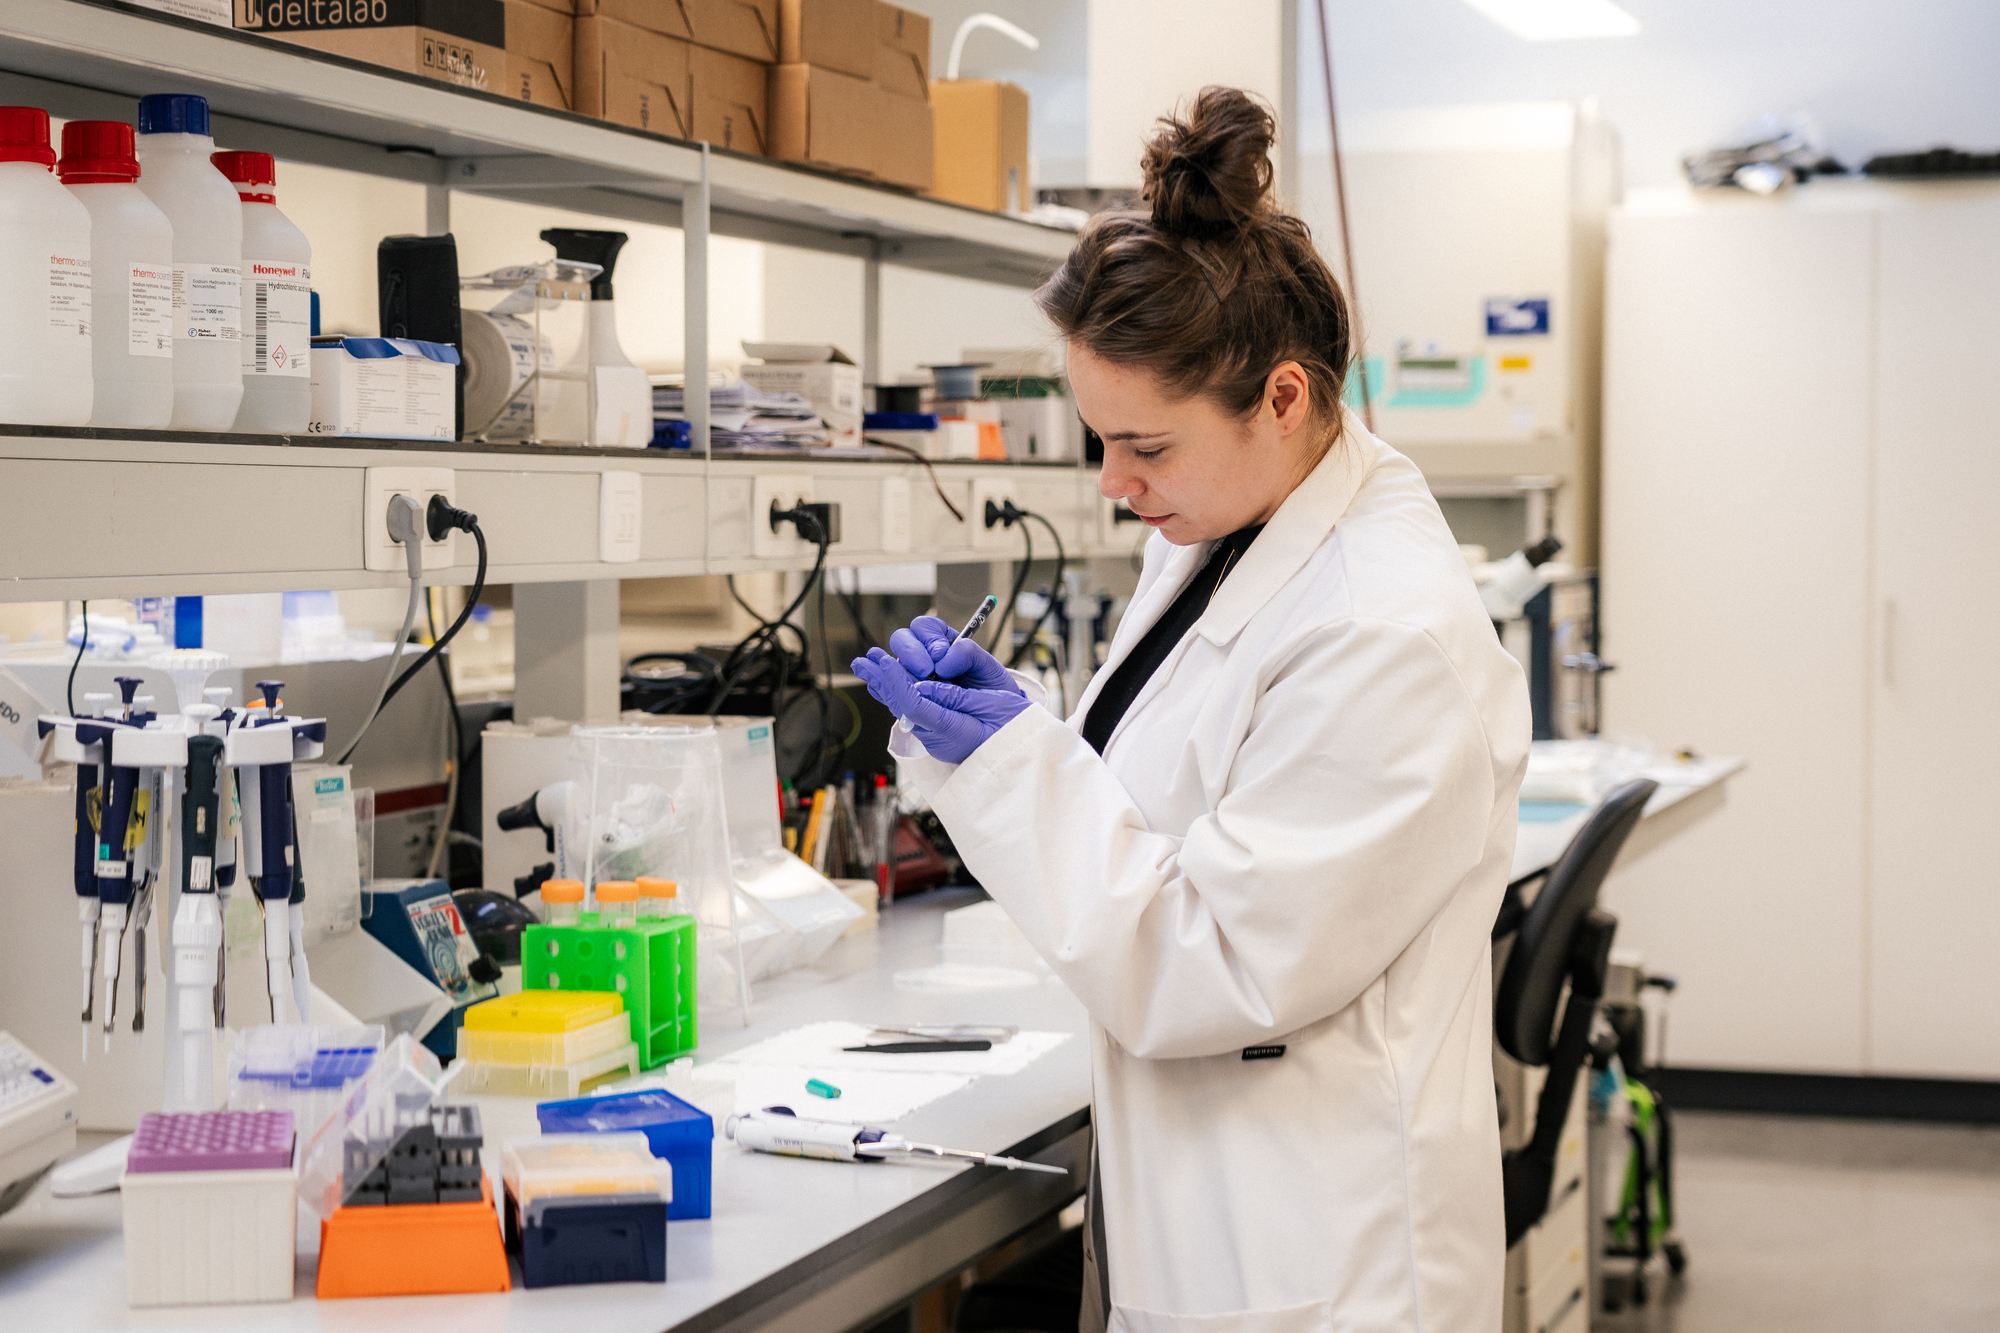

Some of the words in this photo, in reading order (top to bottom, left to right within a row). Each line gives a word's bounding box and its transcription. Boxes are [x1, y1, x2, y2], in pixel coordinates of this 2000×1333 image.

[268, 0, 387, 27] deltalab
[50, 254, 76, 266] thermo
[133, 268, 157, 279] thermo
[210, 267, 236, 275] VOLUMETRIC
[253, 264, 296, 278] Honeywell
[268, 281, 298, 291] Hydrochloric
[445, 903, 467, 936] 2
